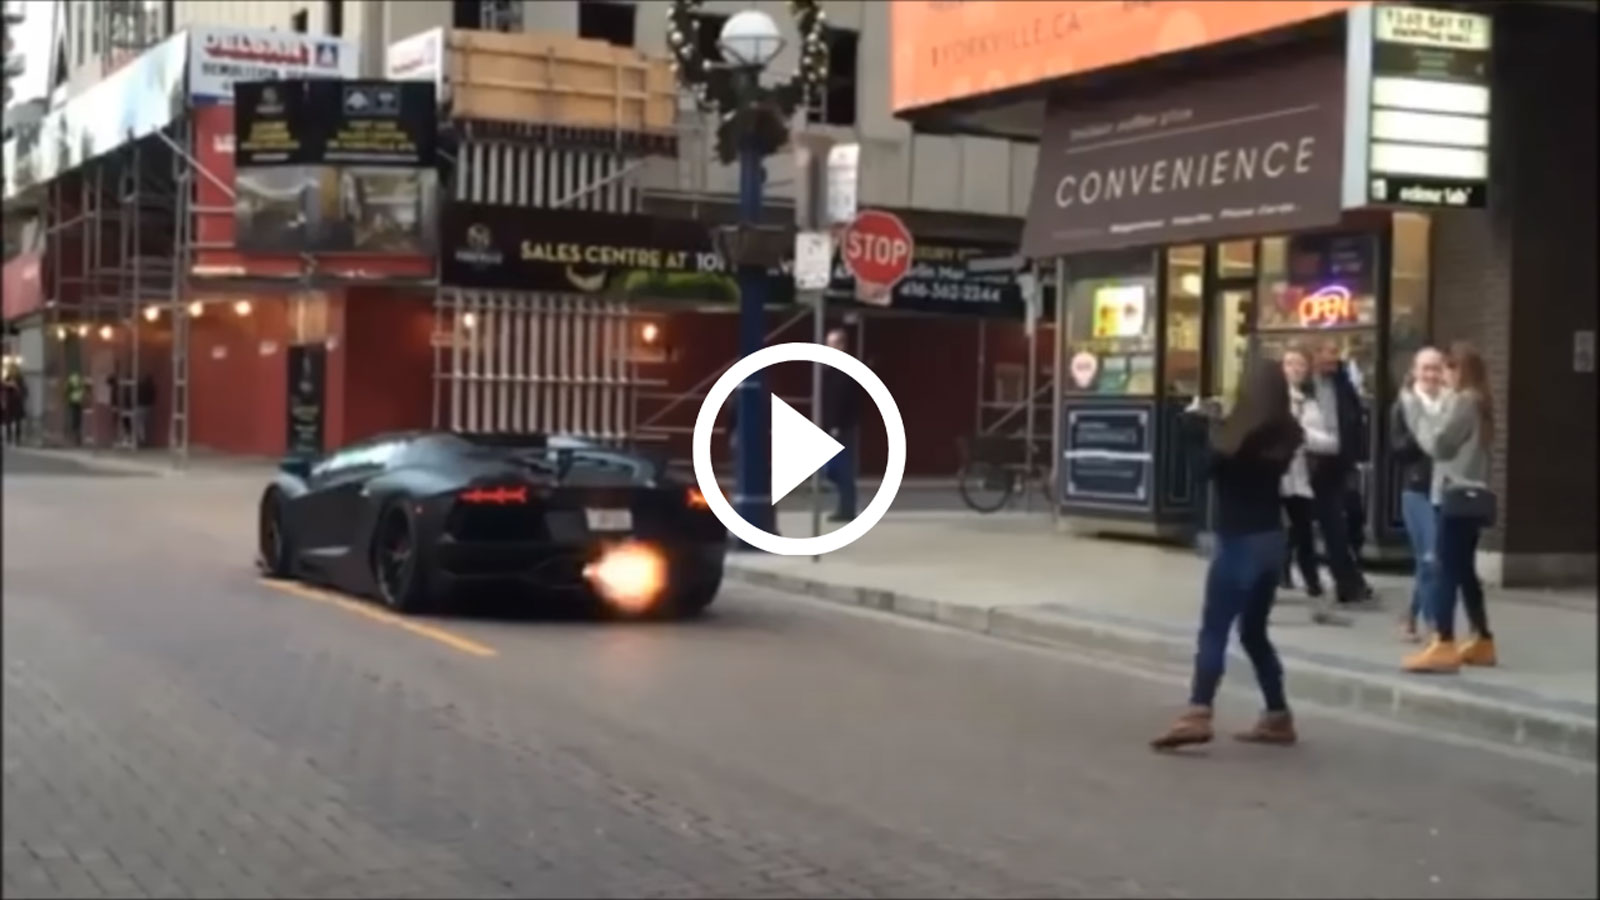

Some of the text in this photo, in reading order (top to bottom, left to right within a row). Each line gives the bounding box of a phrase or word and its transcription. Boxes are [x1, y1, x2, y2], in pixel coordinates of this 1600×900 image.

[1055, 136, 1316, 208] CONVENIENCE
[520, 239, 581, 263] SALES
[584, 245, 661, 268] CENTRE
[664, 251, 687, 270] AT
[849, 232, 907, 267] STOP
[1299, 294, 1354, 325] OPEN
